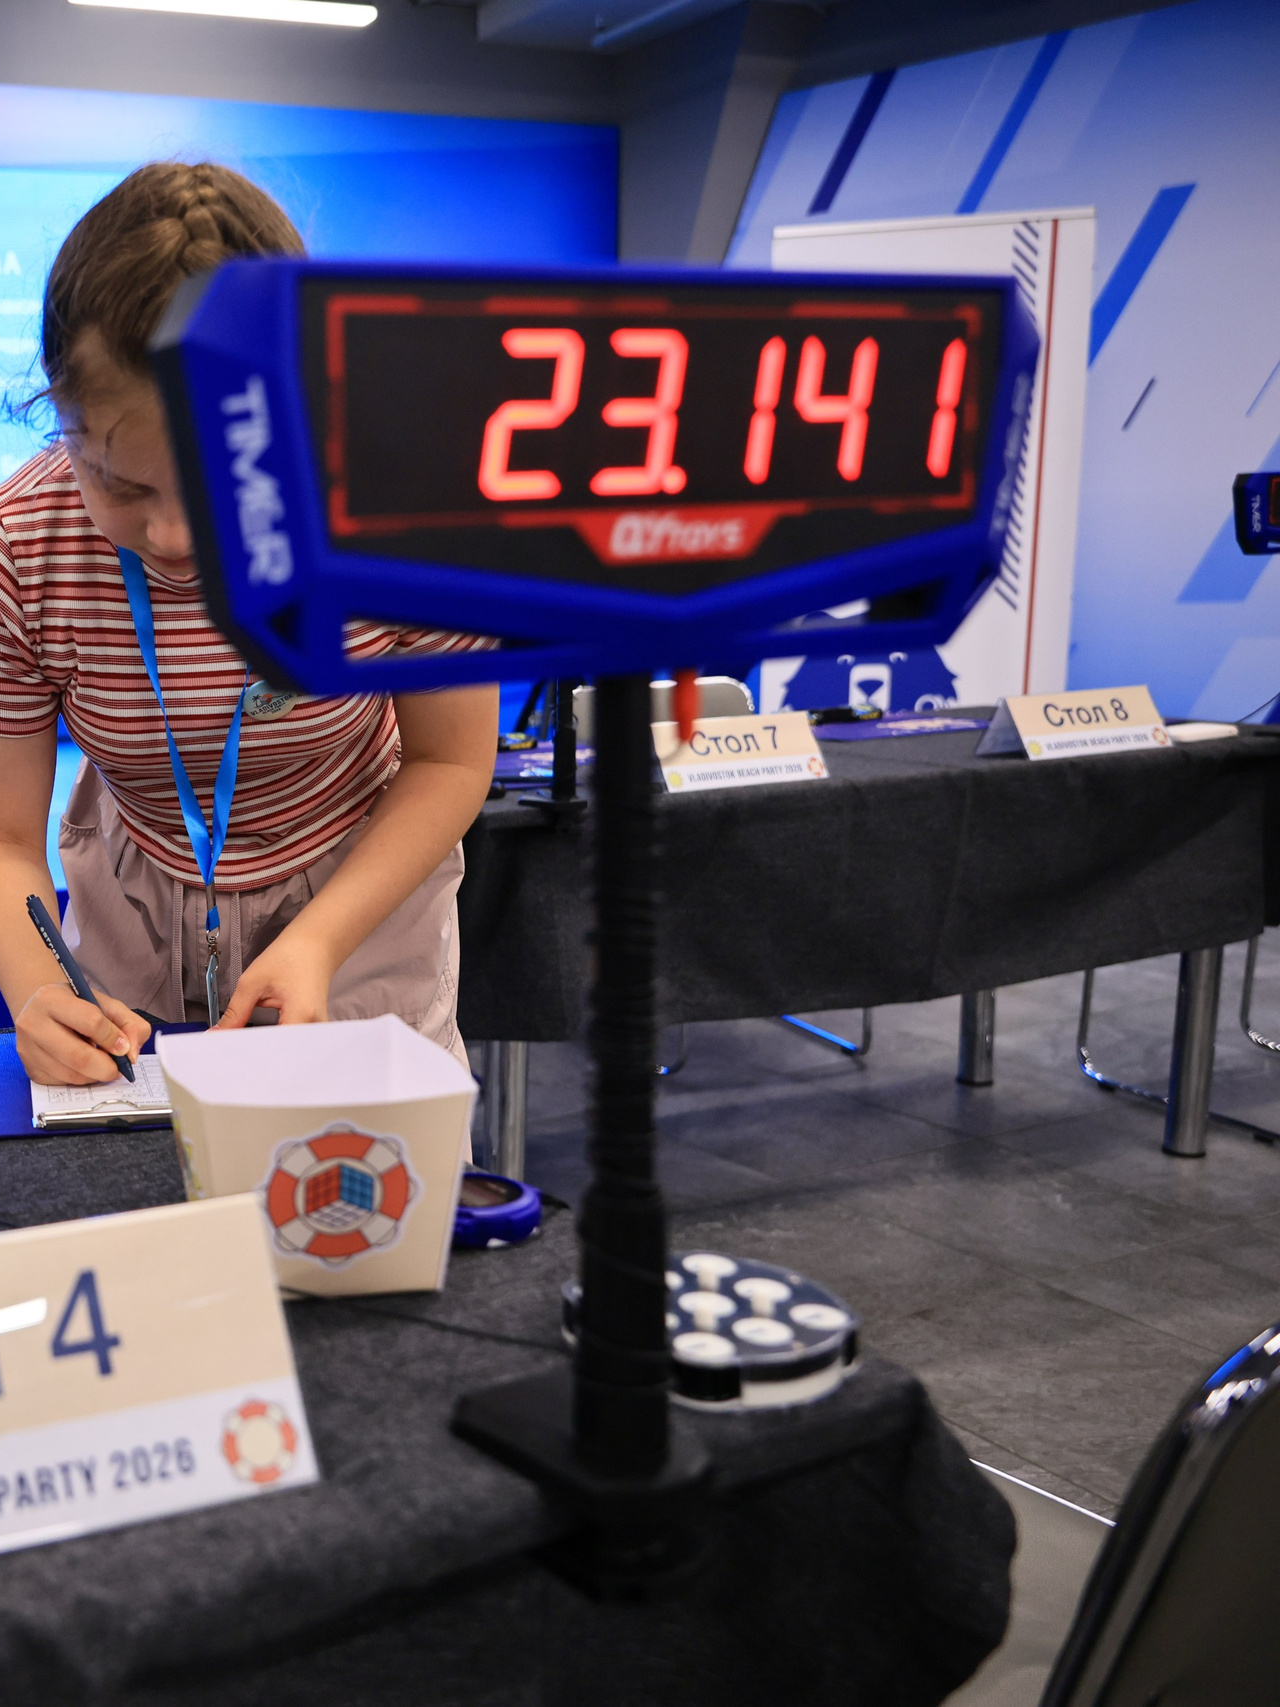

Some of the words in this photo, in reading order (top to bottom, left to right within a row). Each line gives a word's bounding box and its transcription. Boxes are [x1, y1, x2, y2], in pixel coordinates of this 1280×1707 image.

[478, 328, 967, 500] 23.141
[220, 374, 294, 587] TIMER
[1043, 703, 1108, 727] Стол
[1110, 698, 1129, 721] 8
[688, 730, 761, 756] Стол
[762, 725, 778, 750] 7
[687, 769, 736, 783] VLADIVOSTOK
[736, 767, 761, 779] BEACH
[761, 765, 784, 776] PARTY
[50, 1268, 124, 1379] 4
[109, 1437, 197, 1491] 2026
